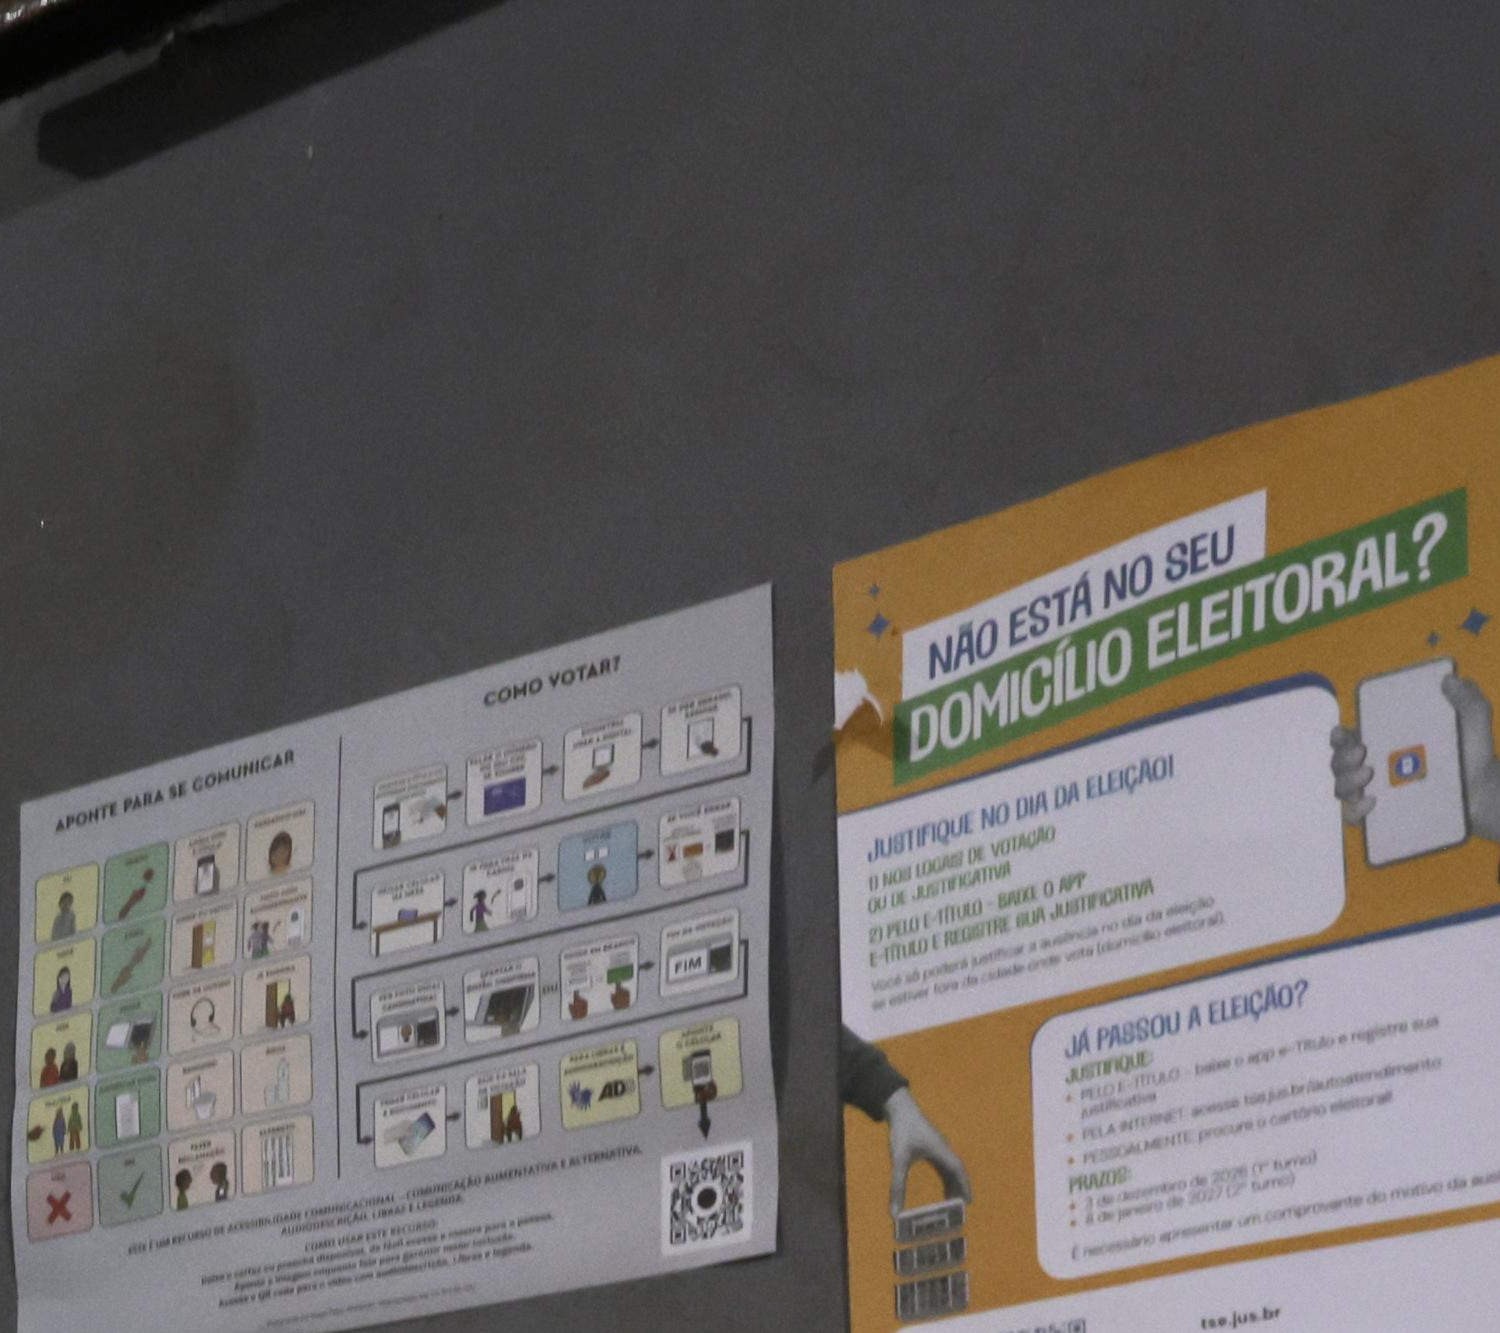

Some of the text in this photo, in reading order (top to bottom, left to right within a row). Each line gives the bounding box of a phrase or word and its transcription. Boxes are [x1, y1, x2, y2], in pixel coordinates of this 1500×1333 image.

[928, 525, 1235, 680] NÃO ESTÁ NO SEU
[907, 511, 1449, 763] DOMICÍLIO ELEITORAL?
[482, 654, 620, 707] COMO VOTAR?
[54, 749, 294, 832] APONTE PARA SE COMUNICAR
[866, 754, 1175, 862] JUSTIFIQUE NO DIA DA ELEIÇÃO!
[966, 845, 985, 865] DE
[989, 825, 1057, 857] VOTAÇÃO
[866, 860, 1011, 915] OU DE JUSTIFICATIVA
[673, 954, 704, 976] FIM
[1063, 979, 1309, 1059] JÁ PASSOU A ELEIÇÃO?
[1199, 1306, 1280, 1330] tse.jus.br
